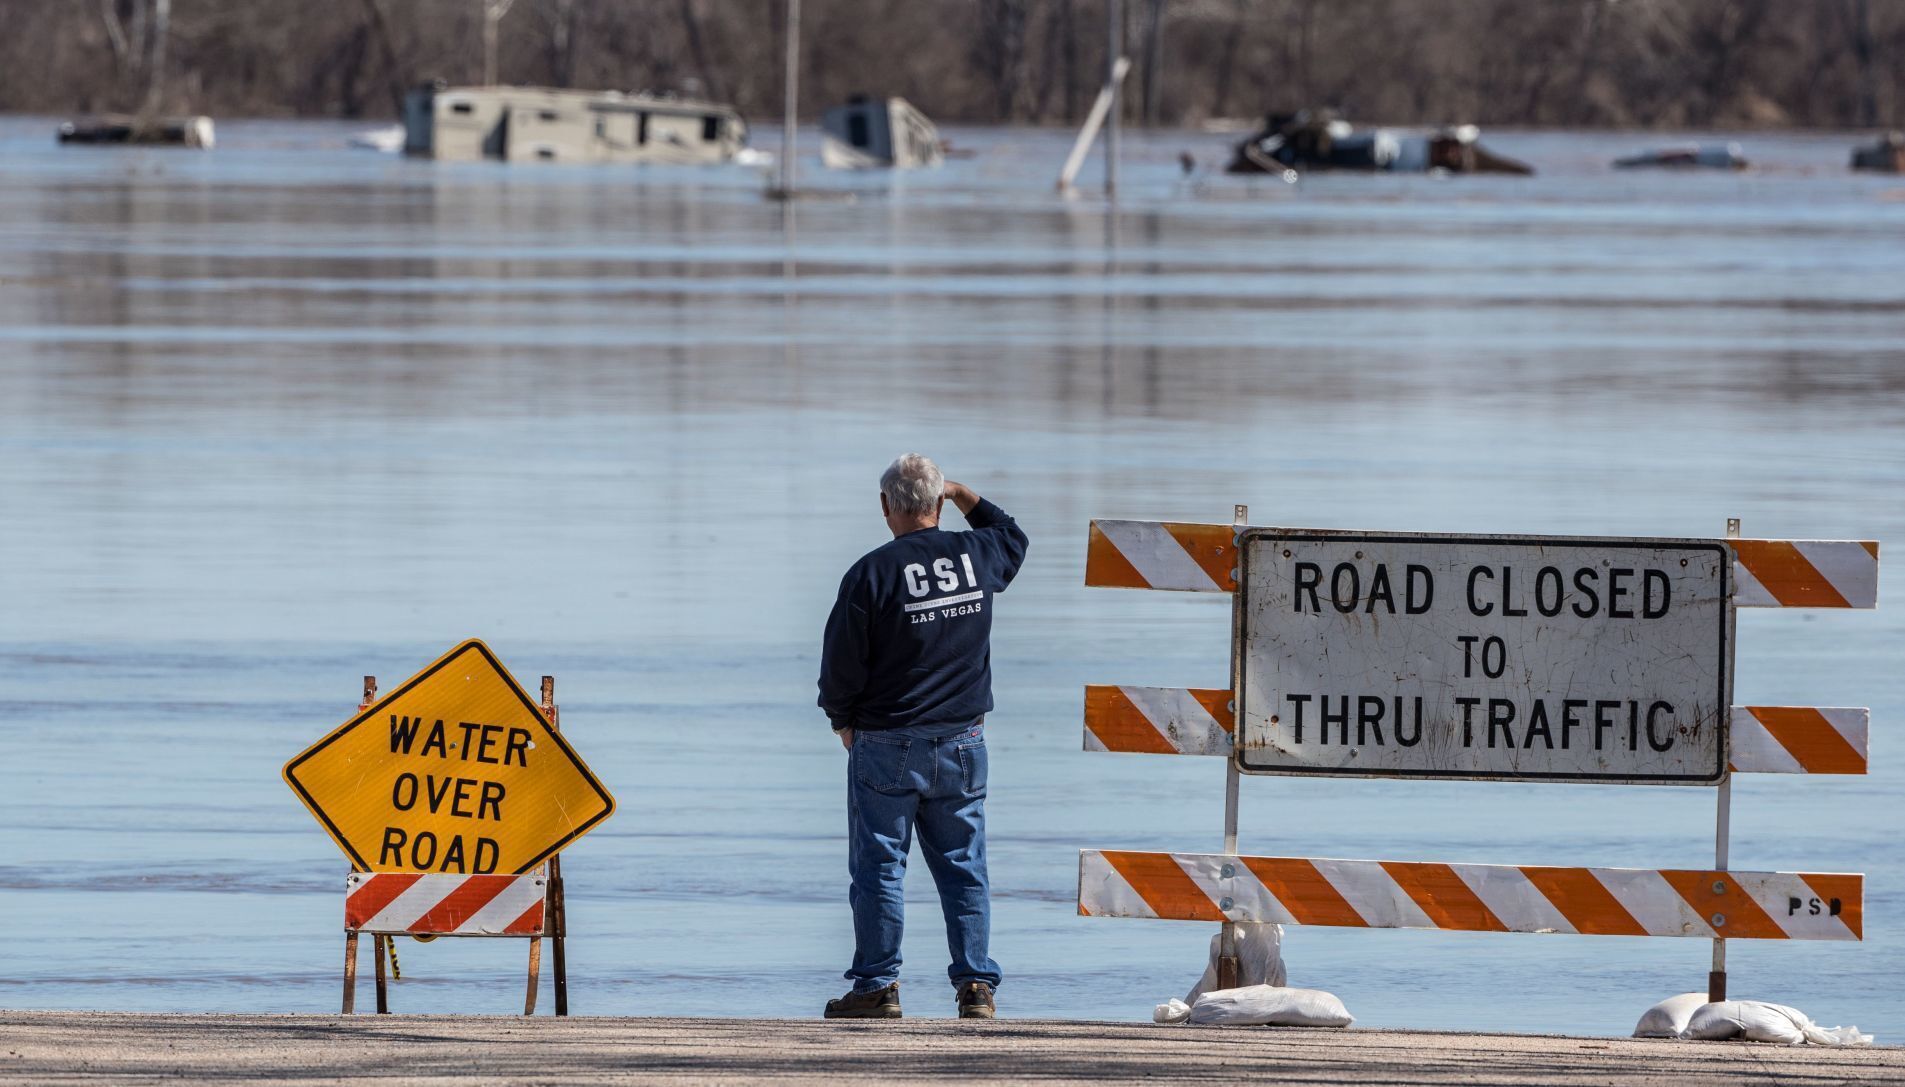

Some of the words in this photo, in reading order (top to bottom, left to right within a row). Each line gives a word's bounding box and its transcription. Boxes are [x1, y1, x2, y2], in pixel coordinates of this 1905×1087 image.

[904, 553, 977, 598] CSI
[1294, 562, 1434, 615] ROAD
[1466, 565, 1672, 619] CLOSED
[911, 611, 935, 624] LAS
[941, 603, 982, 618] VEGAS
[1457, 635, 1507, 679] TO
[390, 714, 532, 768] WATER
[1286, 694, 1423, 748] THRU
[1455, 697, 1675, 752] TRAFFIC
[392, 772, 506, 821] OVER
[379, 826, 500, 875] ROAD
